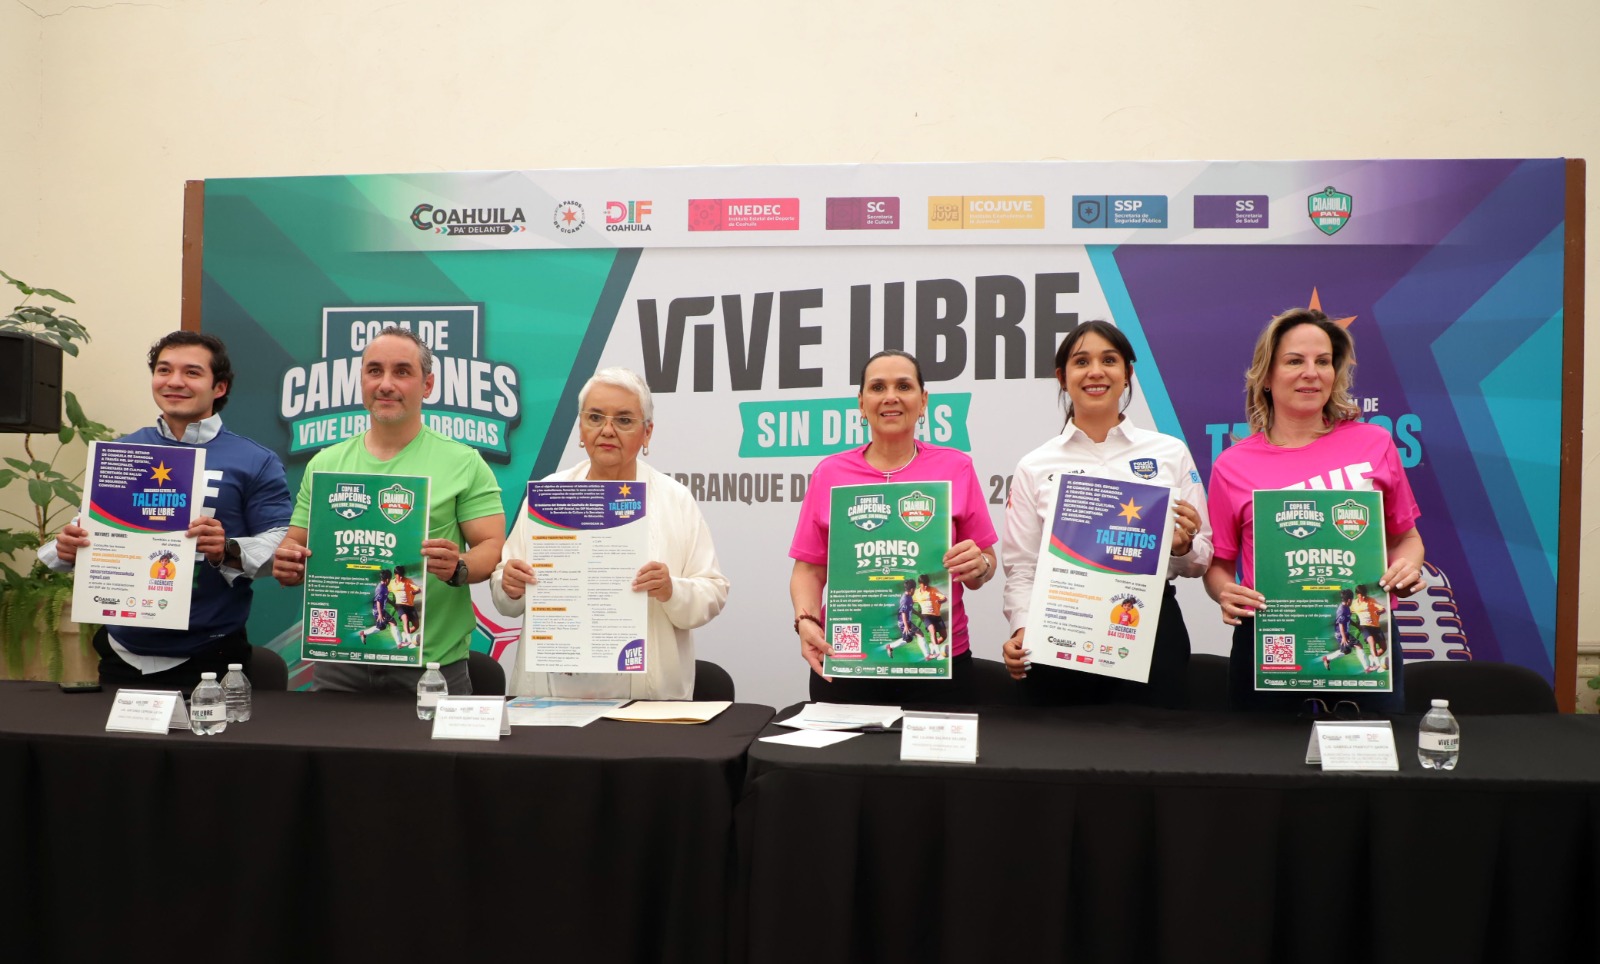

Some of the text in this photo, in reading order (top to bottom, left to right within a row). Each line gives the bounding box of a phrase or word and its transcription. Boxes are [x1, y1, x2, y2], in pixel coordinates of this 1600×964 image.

[728, 204, 781, 216] INEDEC
[867, 201, 885, 212] SC
[970, 200, 1032, 211] ICOJUVE
[1115, 200, 1142, 211] SSP
[1236, 200, 1254, 211] SS
[1312, 197, 1348, 211] COAHUILA
[410, 203, 526, 230] COAHUILA
[606, 201, 652, 223] DIF
[931, 212, 959, 221] JUVE
[561, 219, 586, 233] GIGANTE
[1319, 217, 1340, 225] MUNDO
[468, 225, 506, 234] DELANTE
[419, 320, 448, 350] DE
[637, 272, 1080, 393] VIVE LIBRE
[1363, 398, 1379, 412] DE
[299, 418, 338, 446] VIVE
[430, 415, 498, 446] DROGAS
[756, 411, 810, 448] SIN
[132, 493, 186, 507] TALENTOS
[329, 492, 371, 504] CAMPEONES
[609, 501, 641, 510] TALENTOS
[848, 503, 891, 516] CAMPEONES
[142, 508, 175, 516] VIVE LIBRE
[1276, 510, 1324, 522] CAMPEONES
[334, 530, 396, 548] TORNEO
[1096, 529, 1157, 550] TALENTOS
[353, 546, 359, 555] 5
[368, 547, 375, 556] 5
[855, 540, 919, 558] TORNEO
[1106, 546, 1142, 558] VIVE LIBRE
[875, 557, 881, 567] 5
[891, 557, 897, 567] 5
[1285, 549, 1356, 567] TORNEO
[1309, 566, 1315, 576] 5
[1326, 566, 1333, 576] 5
[625, 647, 643, 658] VIVE
